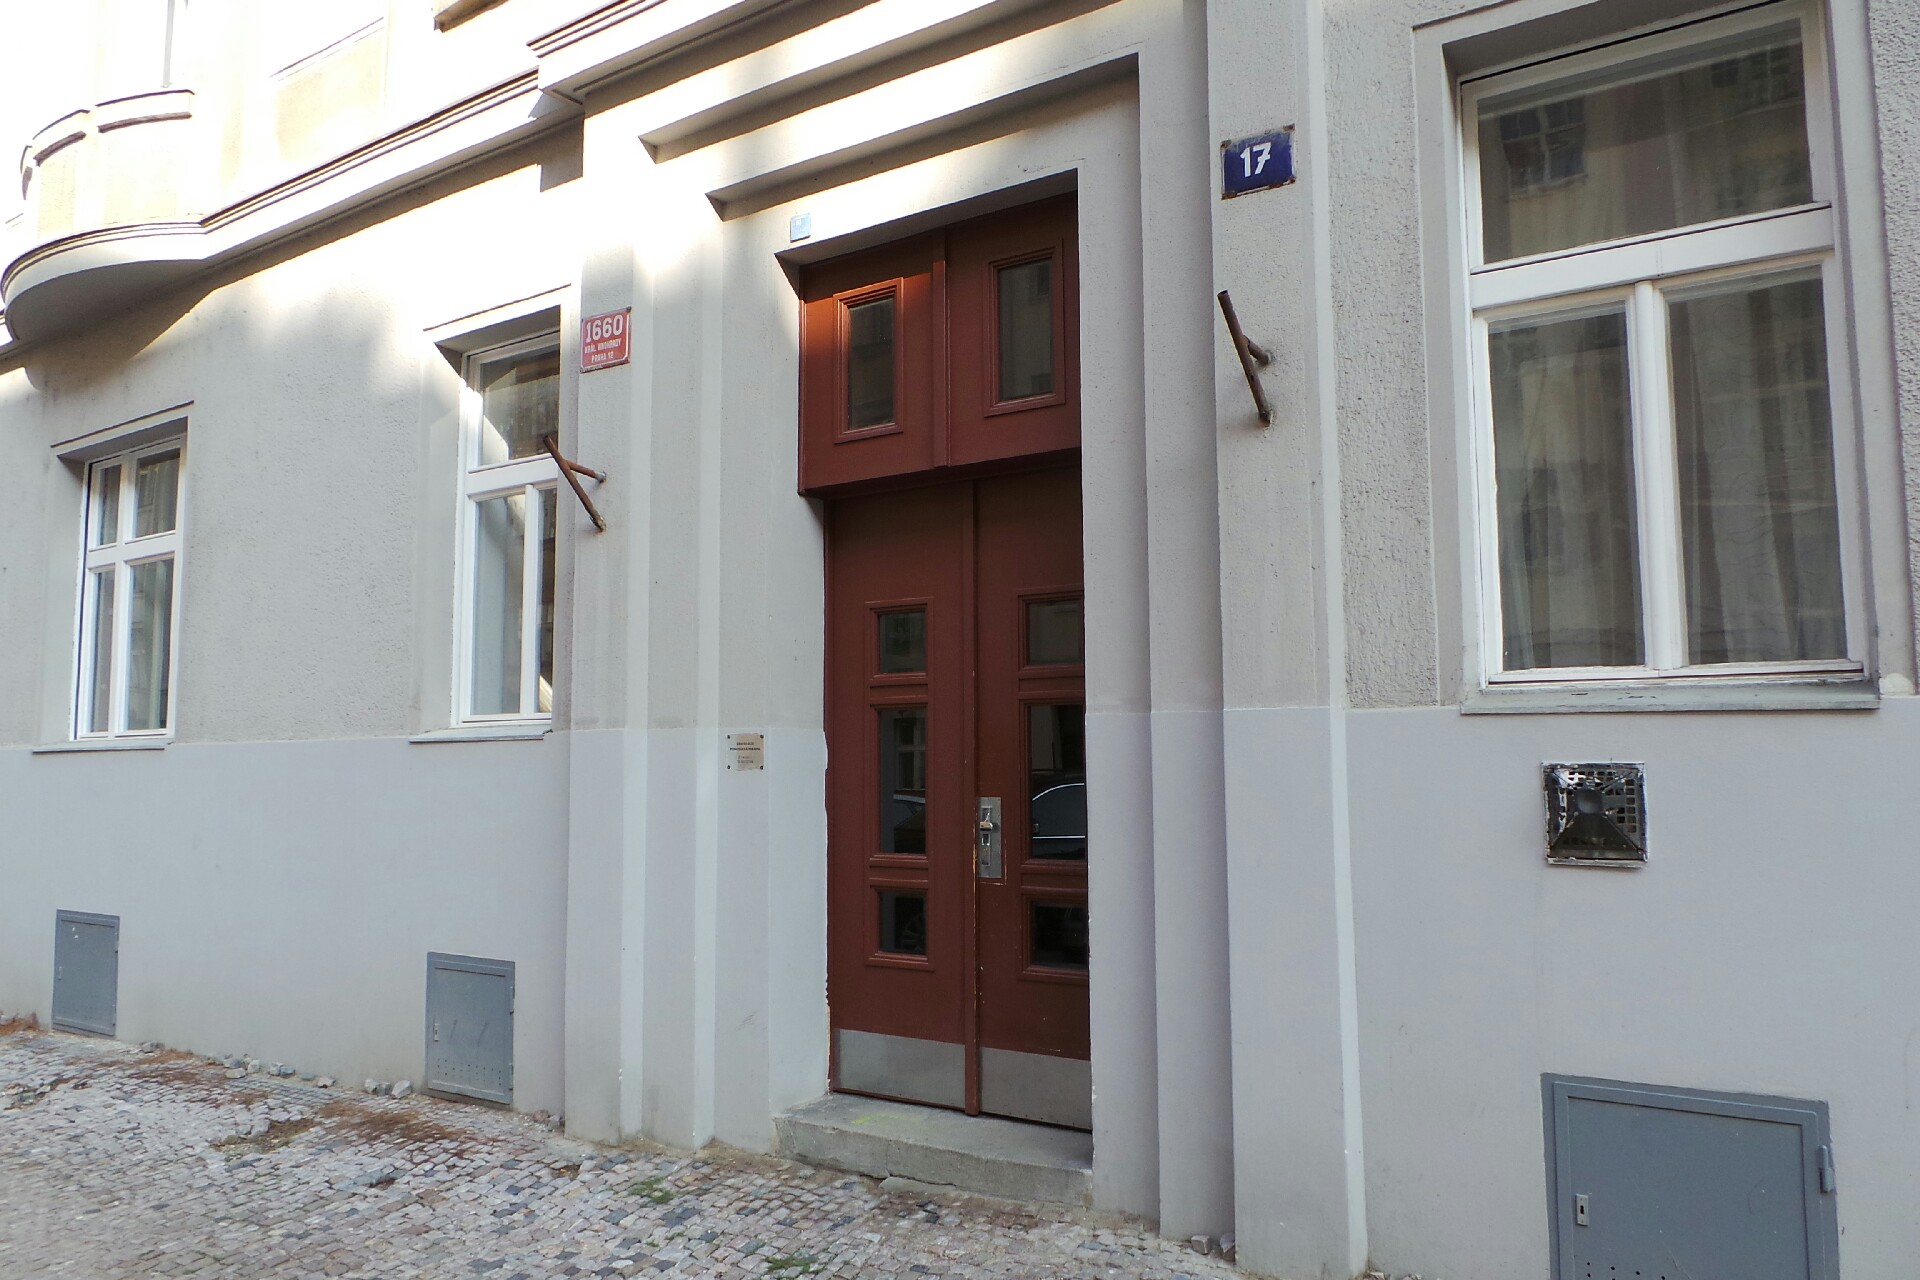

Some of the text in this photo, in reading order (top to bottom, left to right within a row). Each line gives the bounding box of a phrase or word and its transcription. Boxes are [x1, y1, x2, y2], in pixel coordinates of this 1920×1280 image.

[1240, 142, 1272, 178] 17
[585, 314, 624, 343] 1660
[591, 353, 606, 363] PRAHA
